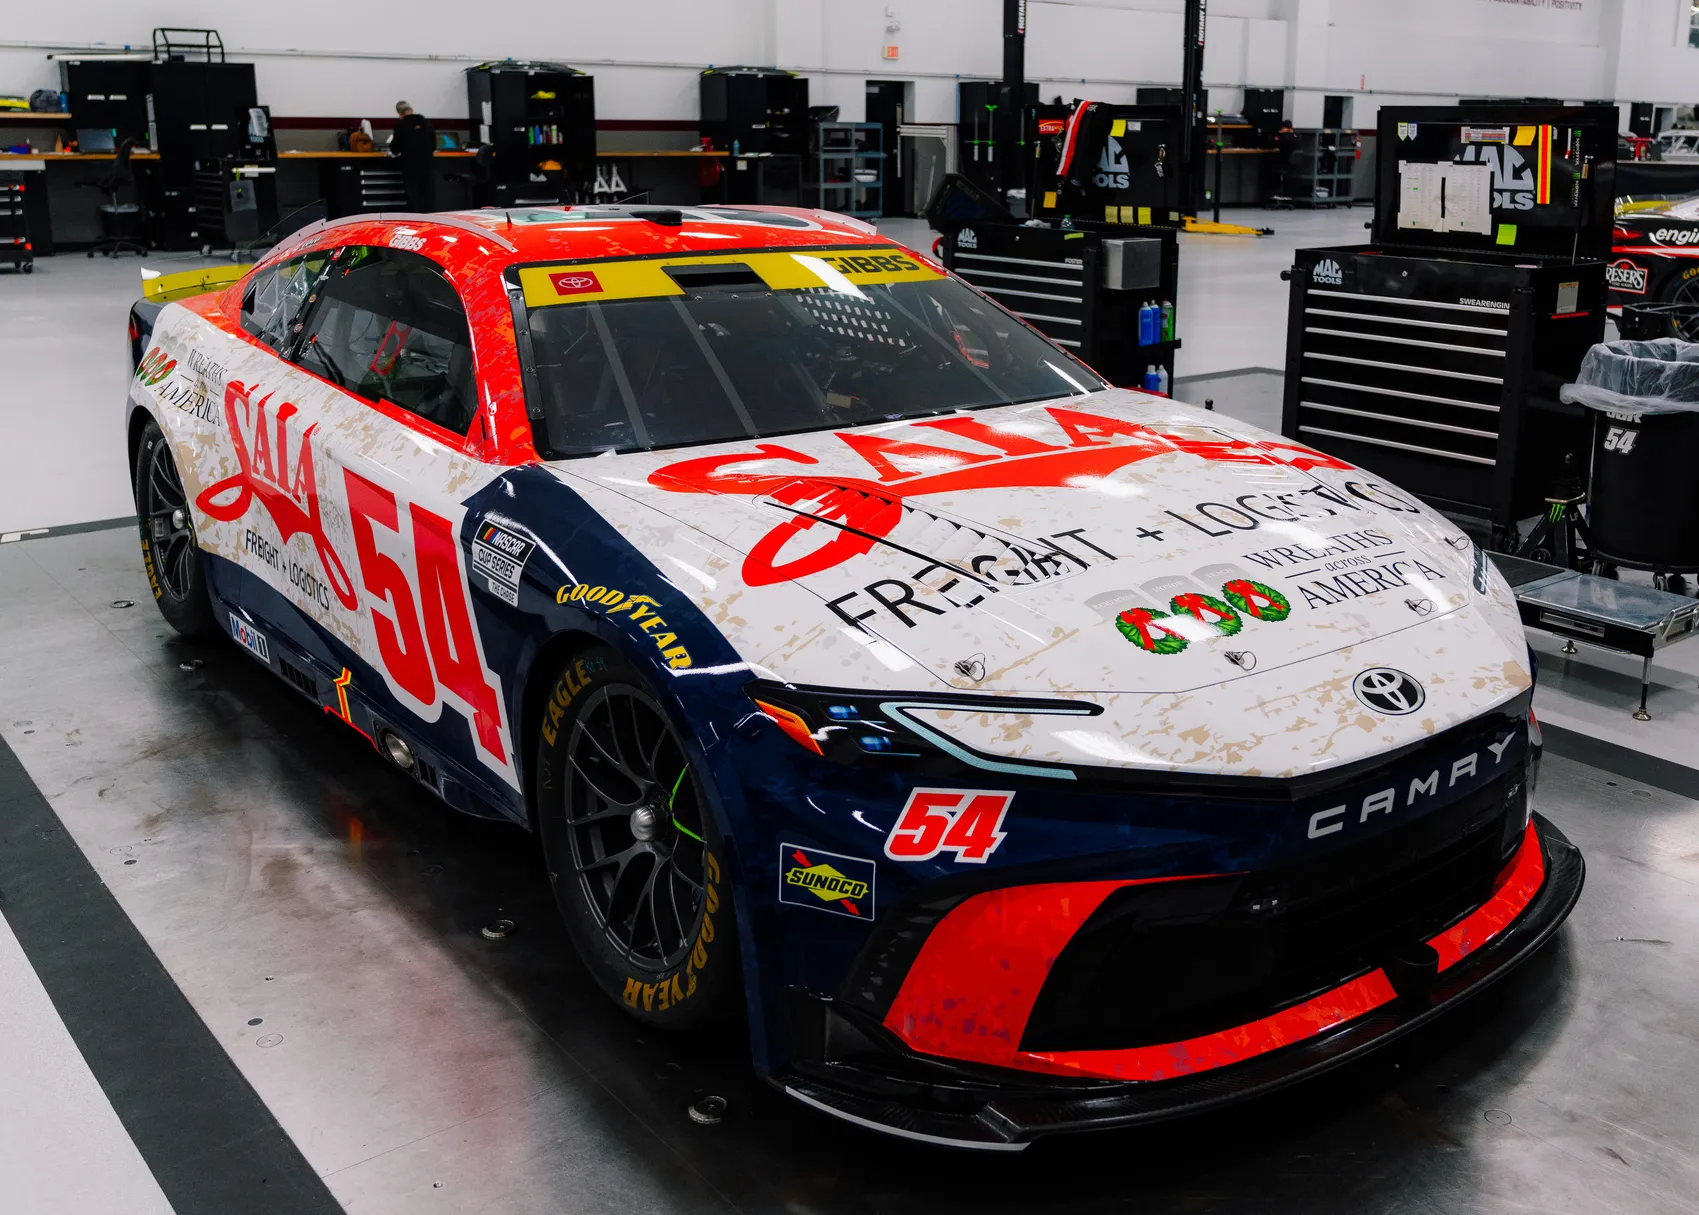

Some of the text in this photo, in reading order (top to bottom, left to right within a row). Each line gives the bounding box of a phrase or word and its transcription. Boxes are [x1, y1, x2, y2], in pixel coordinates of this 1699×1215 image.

[1095, 173, 1130, 189] OLS
[389, 233, 427, 251] GIBBS
[957, 228, 978, 243] MAC
[957, 241, 978, 249] TOOLS
[819, 255, 920, 274] GIBBS
[1312, 259, 1343, 278] MAC
[1312, 276, 1343, 285] TOOLS
[1459, 297, 1510, 309] SWEARENGIN
[187, 348, 228, 387] WREATHS
[153, 380, 220, 427] AMERICA
[1603, 426, 1637, 455] 54
[491, 531, 526, 557] NASCAR
[1241, 529, 1394, 570] WREATHS
[141, 538, 163, 601] EAGLE
[245, 529, 279, 571] FREIGHT
[289, 559, 330, 611] LOGISTICS
[478, 548, 515, 579] CUP SERIES
[1324, 554, 1372, 572] across
[492, 581, 515, 604] THE CHASE
[825, 528, 1119, 638] FREGHT
[1297, 559, 1446, 610] AMERICA
[231, 615, 257, 652] Mobil
[343, 467, 512, 775] 54
[556, 584, 693, 670] GOODYEAR
[542, 659, 593, 747] EAGLE
[1307, 731, 1516, 839] CAMRY
[886, 788, 1014, 863] 54
[789, 869, 866, 898] SUNOCO
[622, 851, 721, 1013] GOODYEAR
